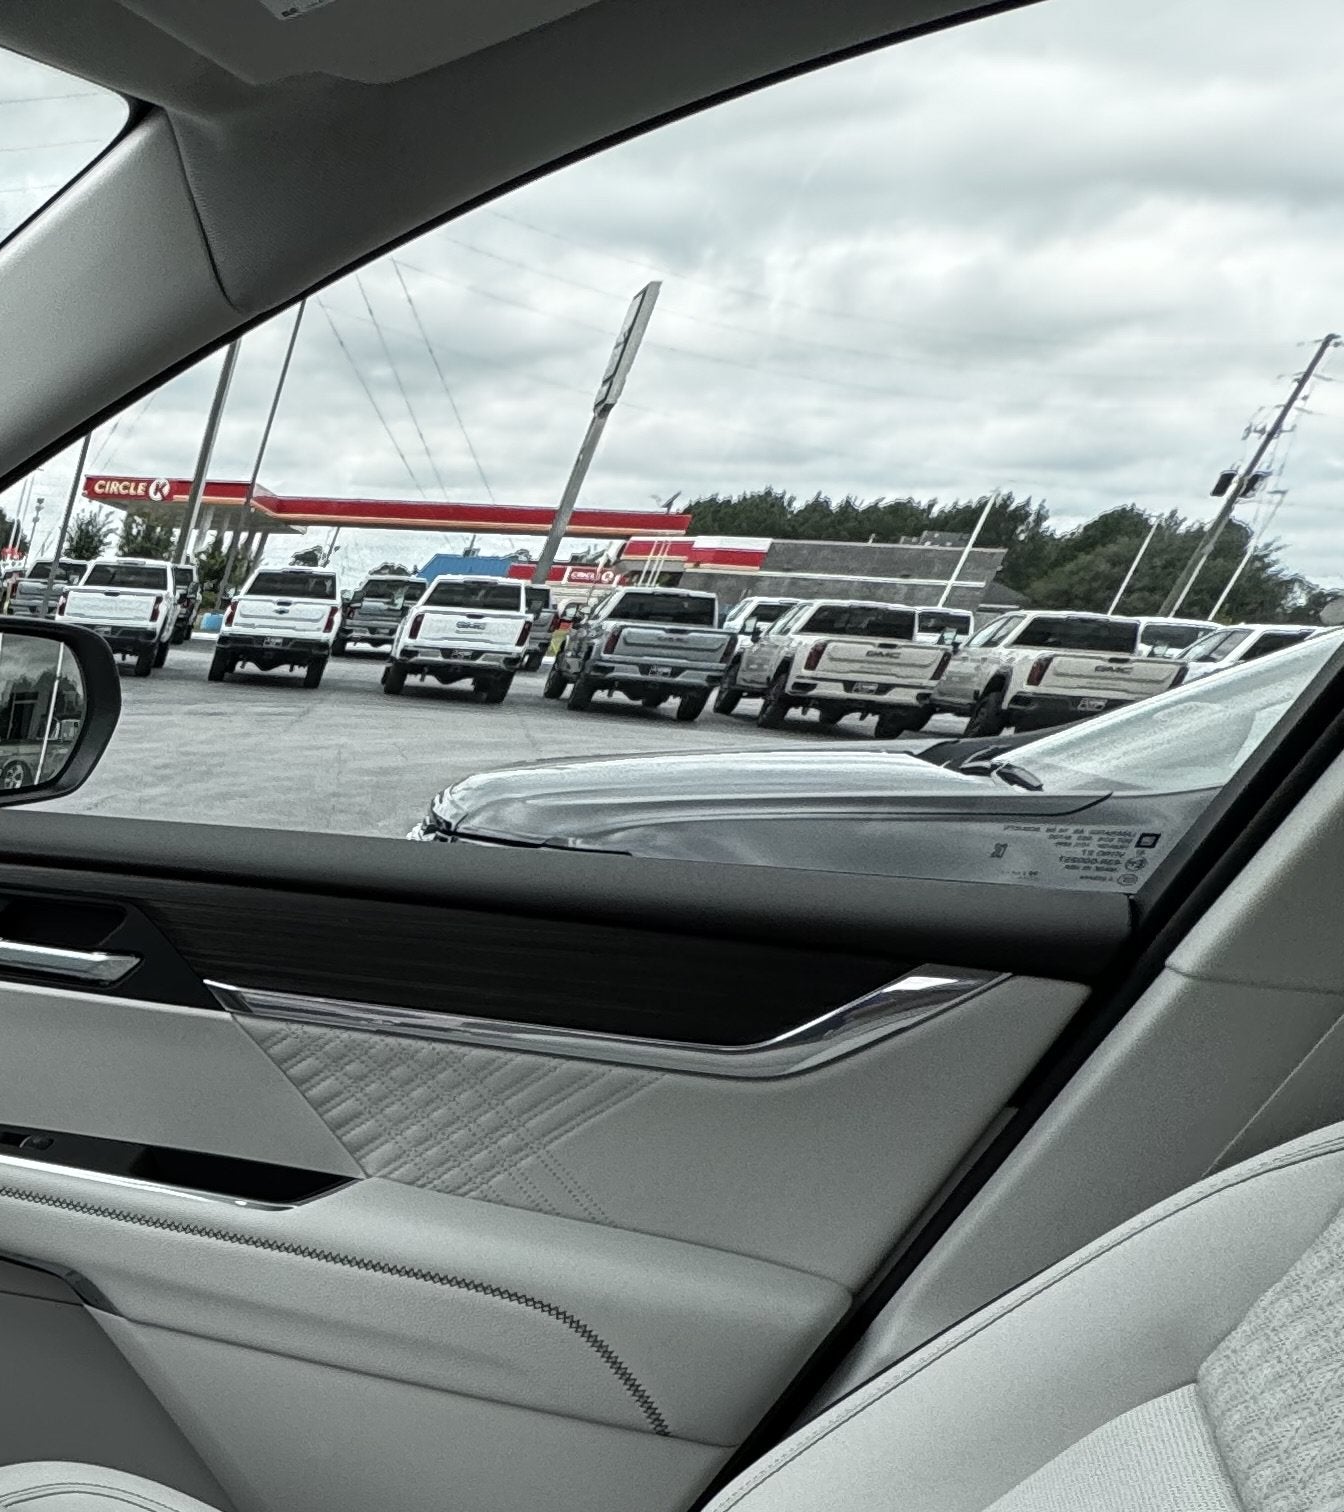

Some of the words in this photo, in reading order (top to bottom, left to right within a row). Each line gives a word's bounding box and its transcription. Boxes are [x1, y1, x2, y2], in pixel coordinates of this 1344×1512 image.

[94, 480, 147, 496] CIRCLE
[153, 481, 168, 500] K
[865, 650, 901, 660] GMC
[1093, 664, 1134, 675] GMC
